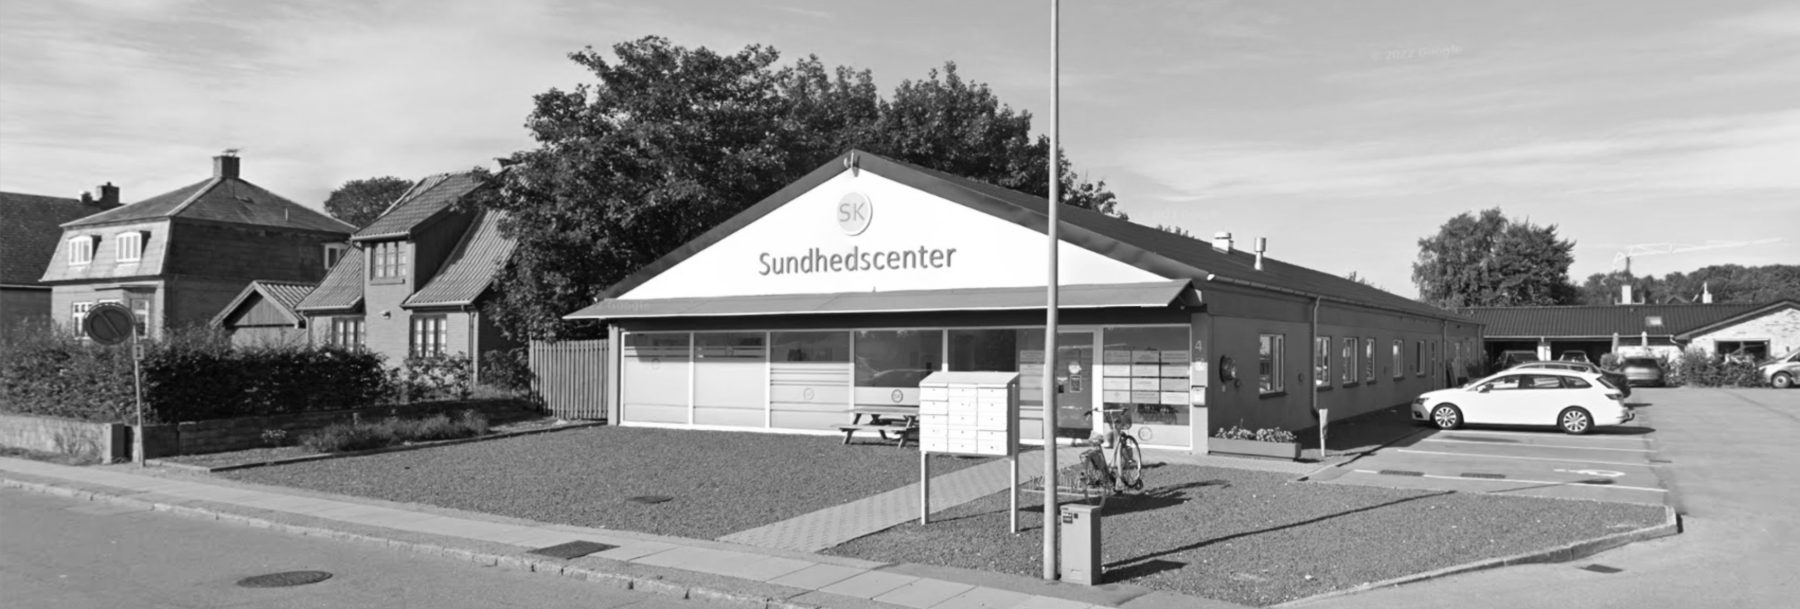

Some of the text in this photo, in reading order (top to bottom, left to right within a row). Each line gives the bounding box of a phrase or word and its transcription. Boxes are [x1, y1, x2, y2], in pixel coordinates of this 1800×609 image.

[839, 202, 865, 222] SK
[759, 245, 957, 276] Sundhedscenter
[1195, 340, 1202, 352] 4
